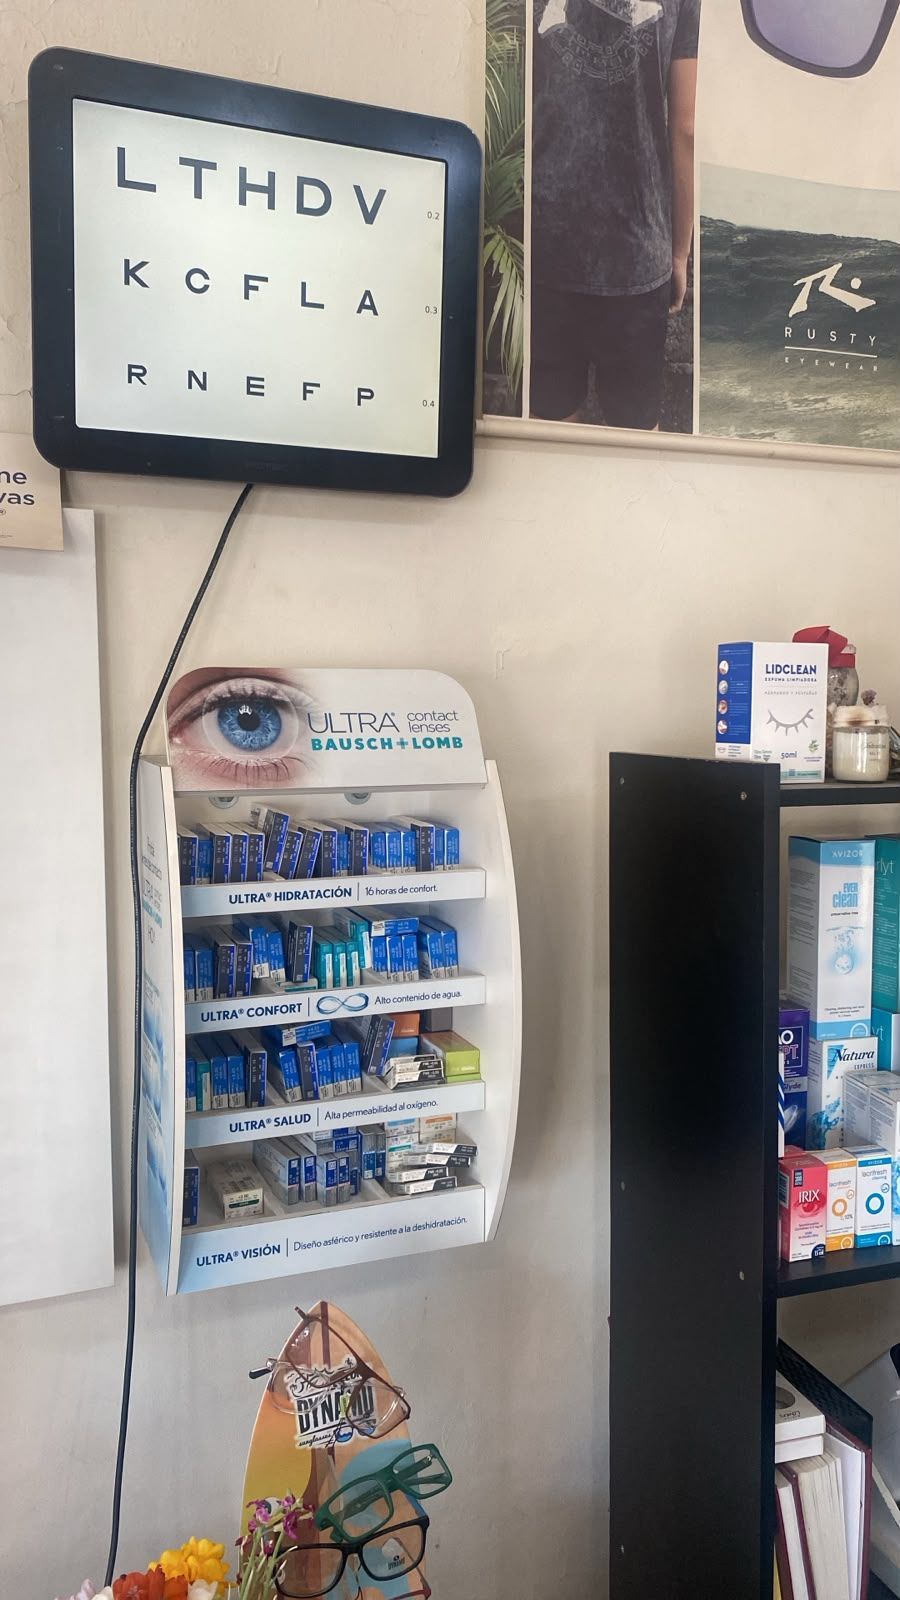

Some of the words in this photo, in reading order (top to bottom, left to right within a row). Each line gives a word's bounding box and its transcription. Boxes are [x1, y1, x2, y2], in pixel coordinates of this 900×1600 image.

[117, 146, 156, 192] L
[179, 156, 217, 199] T
[238, 166, 276, 210] H
[296, 176, 332, 217] D
[353, 185, 387, 225] V
[427, 211, 440, 220] 0.2
[123, 258, 150, 288] K
[185, 268, 210, 294] C
[243, 274, 269, 300] F
[300, 281, 325, 309] L
[356, 289, 379, 316] A
[425, 306, 438, 314] 0.3
[784, 326, 876, 347] RUSTY
[785, 357, 877, 372] EYEWEAR
[127, 364, 148, 386] R
[187, 370, 207, 391] N
[246, 376, 265, 396] E
[302, 382, 321, 400] F
[357, 387, 375, 406] P
[422, 400, 435, 408] 0.4
[765, 663, 817, 675] LIDCLEAN
[407, 710, 458, 722] contact
[408, 721, 451, 733] lenses
[274, 885, 352, 901] HIDRATACIÓN
[365, 886, 375, 896] 16
[375, 885, 397, 895] horas
[398, 885, 408, 894] de
[409, 884, 438, 894] confort.
[832, 890, 858, 908] clean
[247, 1002, 303, 1018] CONFORT
[374, 995, 391, 1005] Alto
[392, 993, 430, 1004] contenido
[431, 993, 441, 1002] de
[442, 992, 462, 1003] agua.
[831, 1048, 875, 1062] Natura
[274, 1113, 311, 1127] SALUD
[324, 1110, 341, 1121] Alta
[342, 1103, 398, 1120] permeabilidad
[398, 1102, 406, 1111] al
[407, 1099, 439, 1113] oxígeno.
[798, 1188, 820, 1203] IRIX
[241, 1243, 281, 1260] VISIÓN
[293, 1239, 322, 1251] Diseño
[323, 1234, 354, 1248] asférico
[354, 1235, 360, 1243] y
[360, 1227, 398, 1241] resistente
[404, 1223, 411, 1233] la
[411, 1215, 468, 1232] deshidratación.
